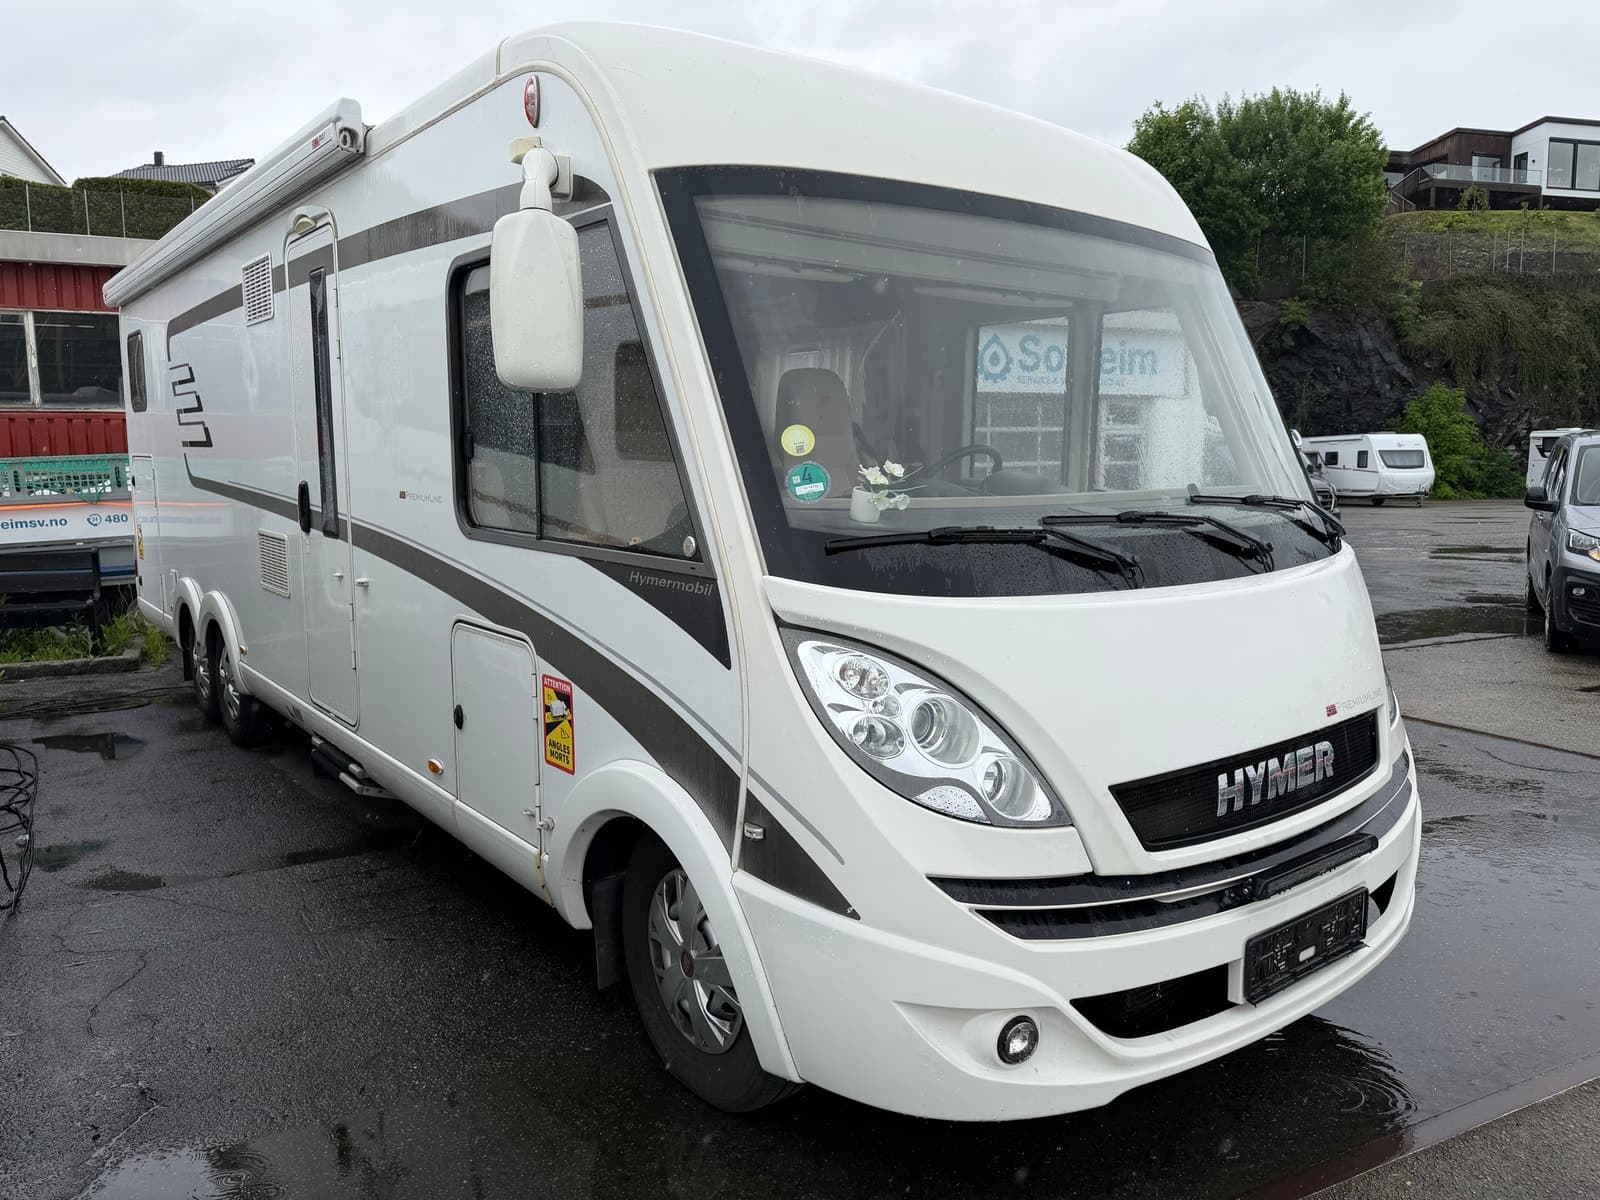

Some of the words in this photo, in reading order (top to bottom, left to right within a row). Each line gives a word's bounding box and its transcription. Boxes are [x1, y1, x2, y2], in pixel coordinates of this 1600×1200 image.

[1019, 334, 1158, 376] Soeim
[802, 466, 813, 482] 4
[104, 513, 129, 524] 480
[629, 570, 714, 597] Hymermobil
[544, 678, 571, 693] ATTENTION
[549, 739, 571, 755] ANGLES
[550, 749, 570, 765] MORTS
[1216, 740, 1335, 817] HYMER
